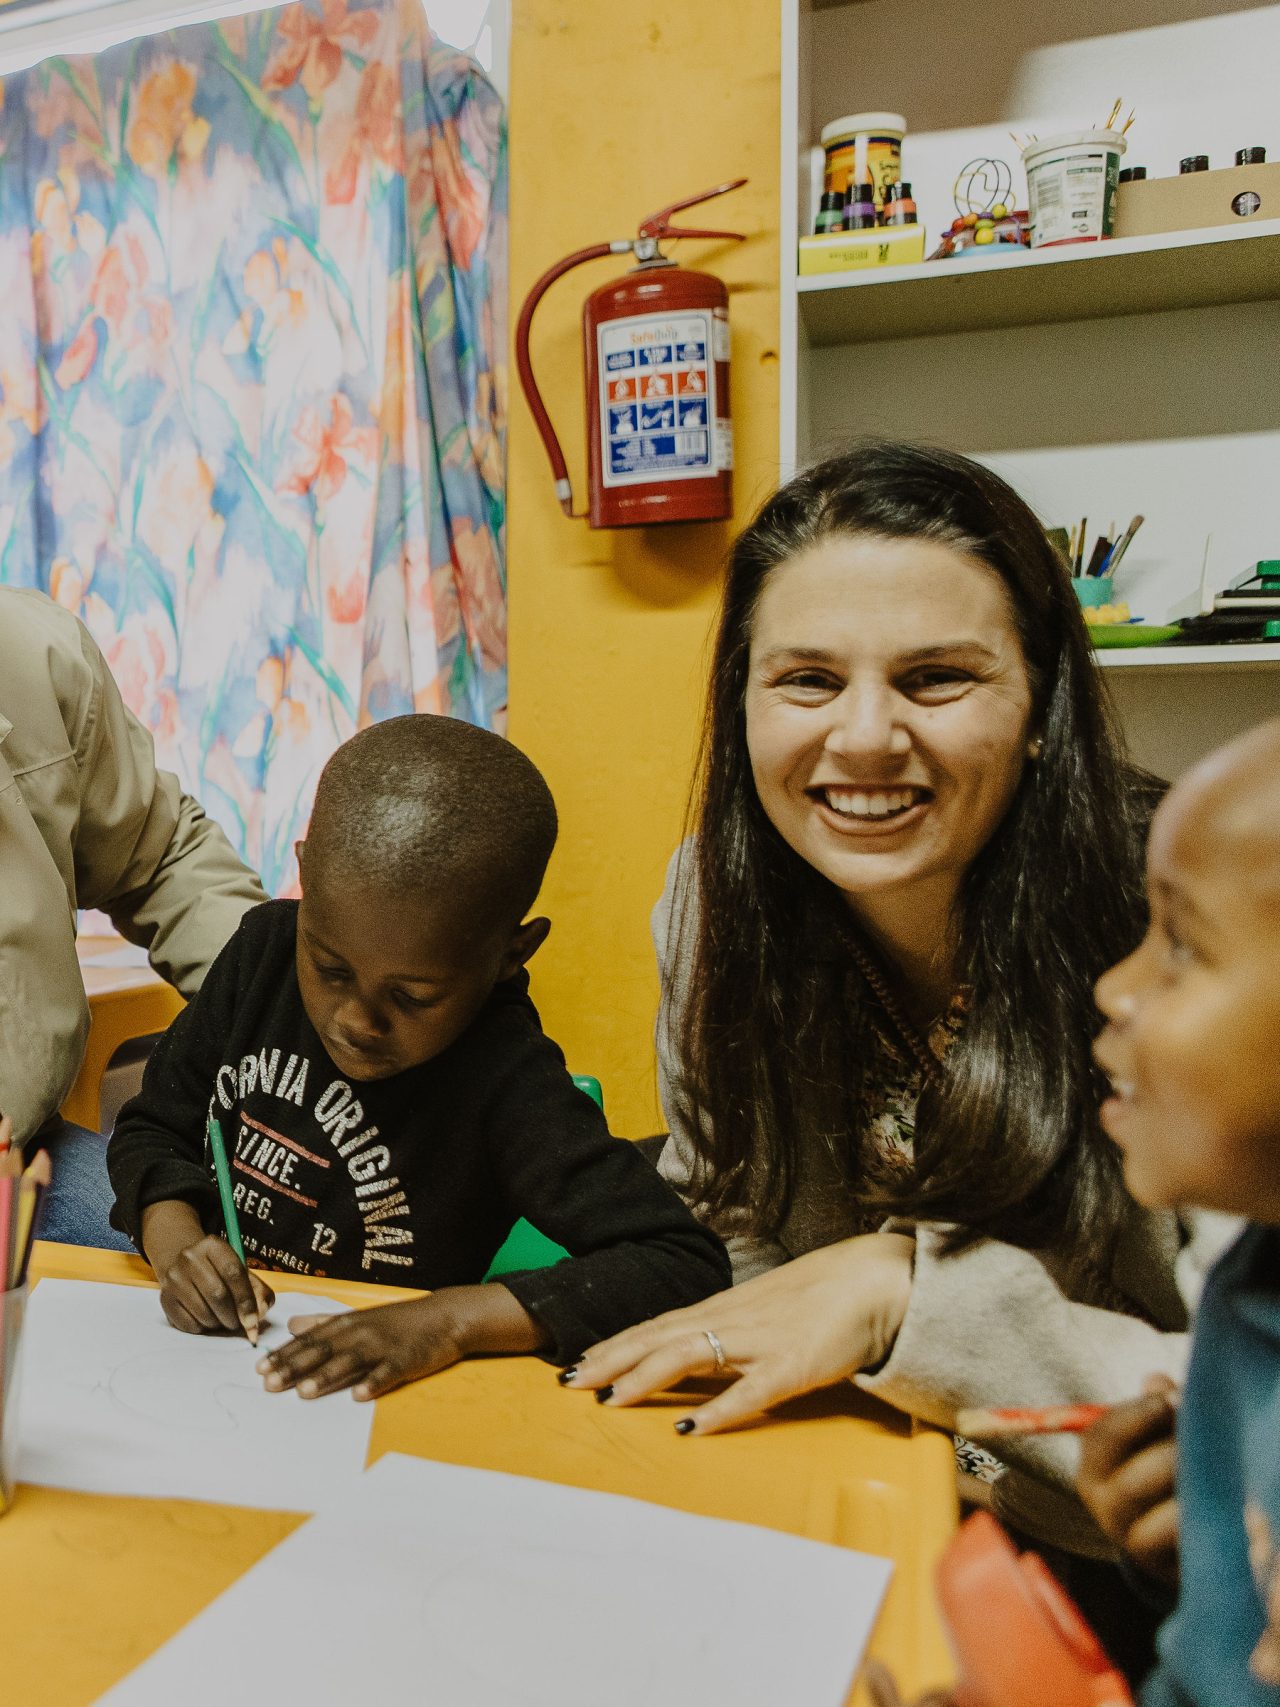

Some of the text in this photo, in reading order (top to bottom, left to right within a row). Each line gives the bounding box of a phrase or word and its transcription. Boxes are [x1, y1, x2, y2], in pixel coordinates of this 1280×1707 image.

[208, 1047, 414, 1270] ORNIA ORIGINAL
[233, 1182, 338, 1256] REG. 12
[260, 1244, 311, 1274] APPAREL
